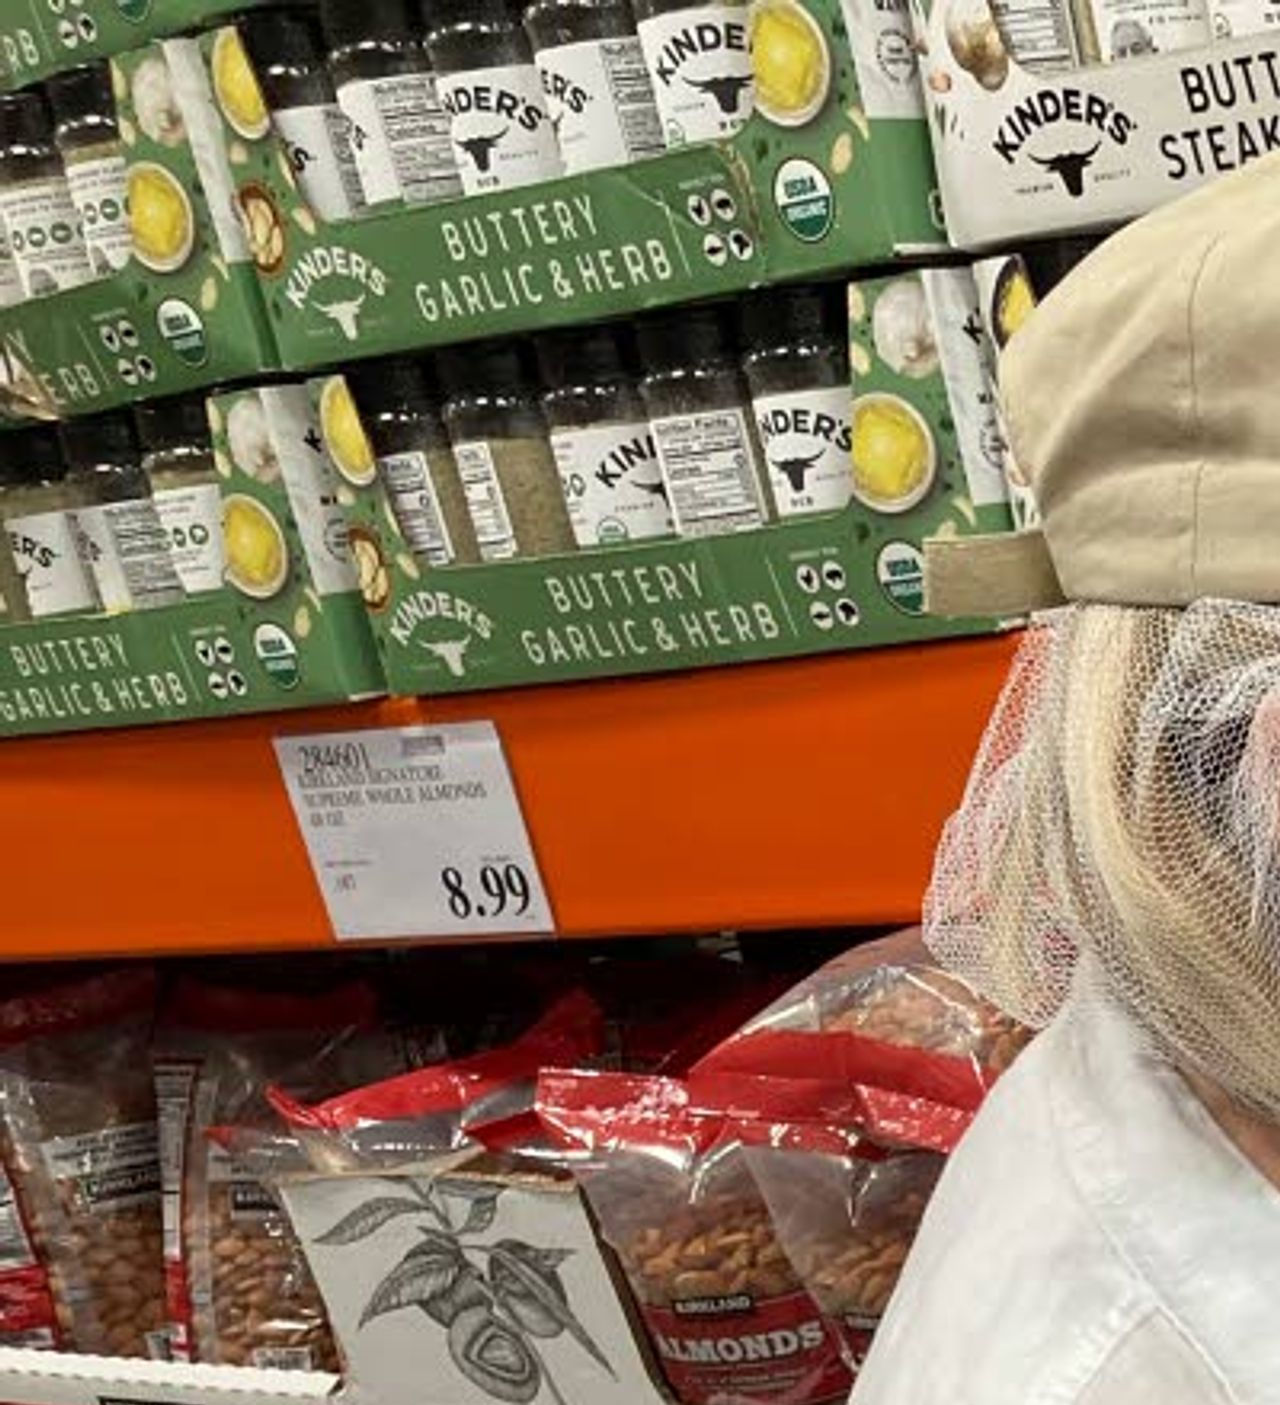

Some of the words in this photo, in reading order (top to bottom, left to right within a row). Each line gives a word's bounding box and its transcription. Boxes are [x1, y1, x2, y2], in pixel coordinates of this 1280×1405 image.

[656, 22, 753, 86] KINDE
[993, 88, 1137, 164] KINDER'S
[443, 195, 598, 261] BUTTERY
[285, 246, 387, 307] KINDER'S
[415, 261, 543, 321] GARLIC
[549, 258, 574, 299] &
[576, 239, 672, 295] HERB
[544, 562, 704, 613] BUTTERY
[389, 591, 494, 646] KINDER'S
[520, 618, 648, 665] GARLIC
[653, 617, 679, 652] &
[684, 601, 781, 648] HERB
[11, 634, 129, 677] BUTTERY
[93, 681, 113, 713] &
[113, 671, 188, 711] HERB
[441, 864, 532, 919] 8.99
